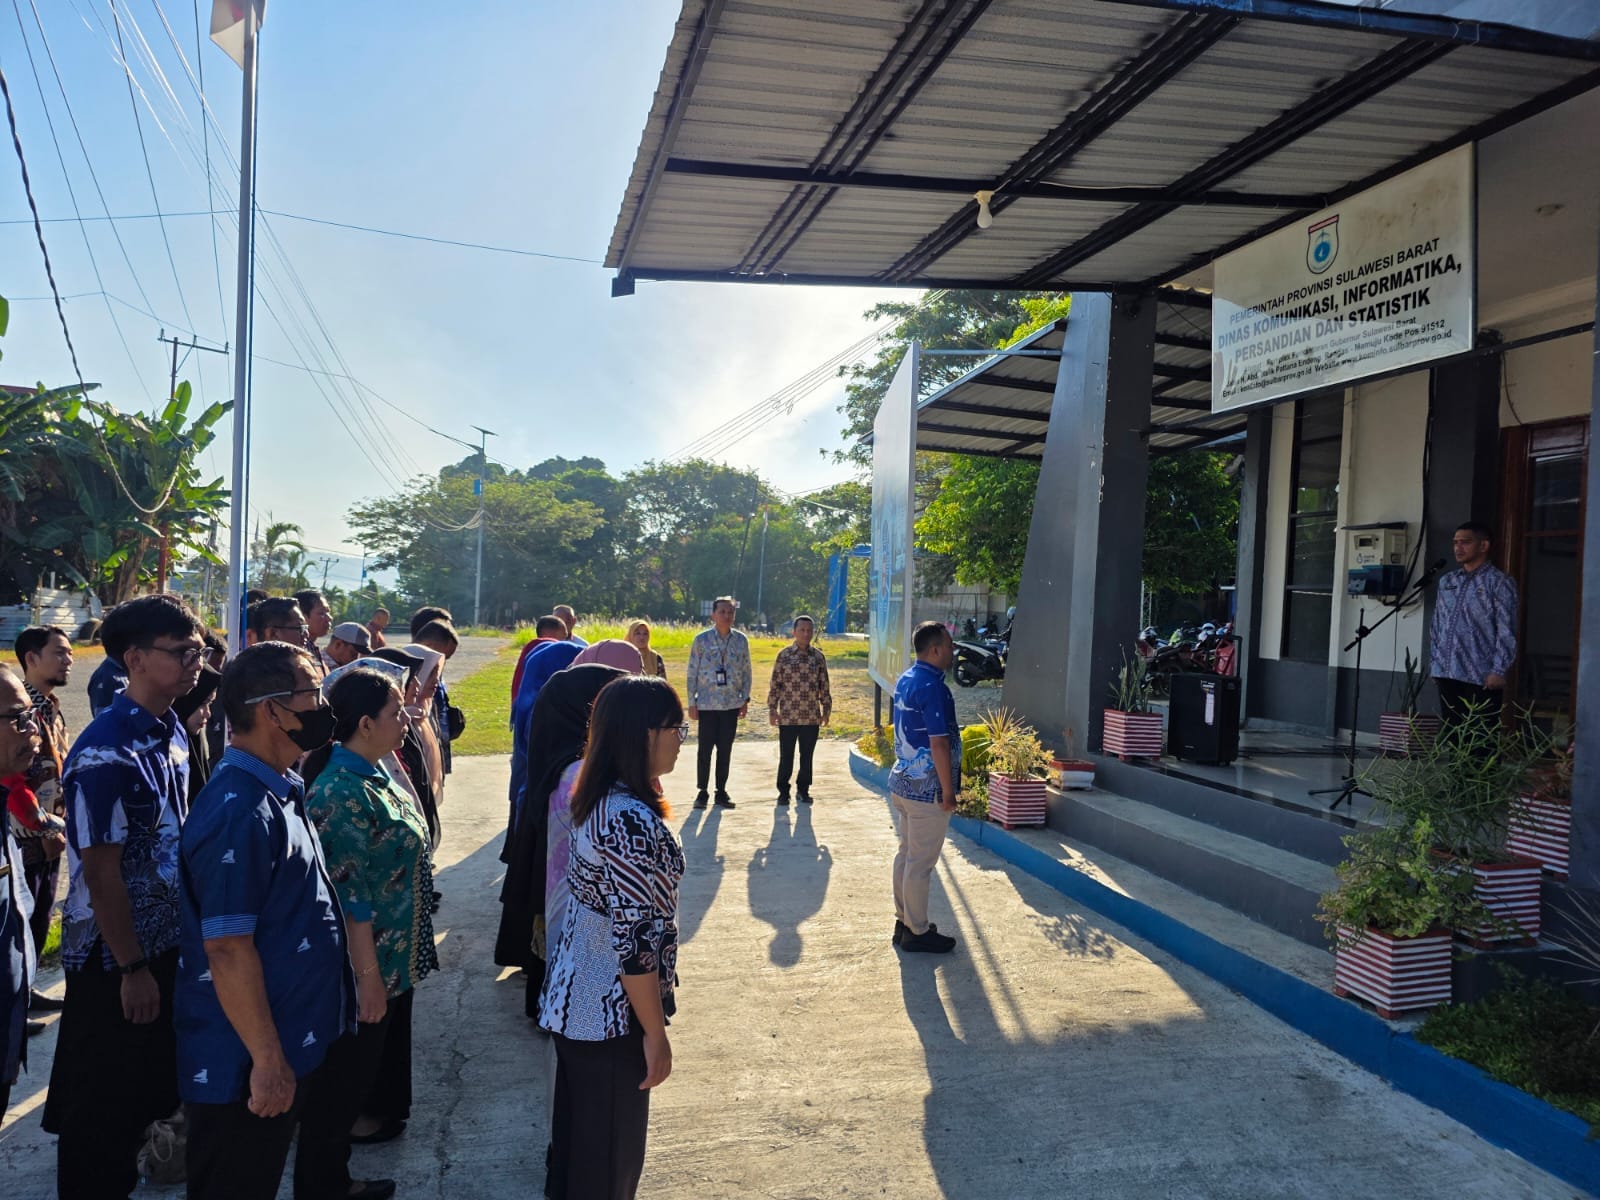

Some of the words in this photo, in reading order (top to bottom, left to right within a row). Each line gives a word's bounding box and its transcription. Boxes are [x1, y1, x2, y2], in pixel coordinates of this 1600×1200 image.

[1218, 325, 1250, 349] DINAS
[1253, 294, 1338, 336] KOMUNIKASI,
[1343, 254, 1462, 306] INFORMATIKA,
[1230, 296, 1284, 325] PEMERINTAH
[1287, 277, 1333, 303] PROVINSI
[1336, 254, 1394, 285] SULAWESI
[1397, 237, 1440, 264] BARAT
[1235, 326, 1311, 363] PERSANDIAN
[1315, 315, 1343, 338] DAN
[1348, 287, 1430, 328] STATISTIK
[1362, 323, 1394, 338] Sulawesi
[1396, 316, 1416, 329] Barat
[1404, 326, 1419, 337] Pos
[1421, 320, 1445, 333] 91512
